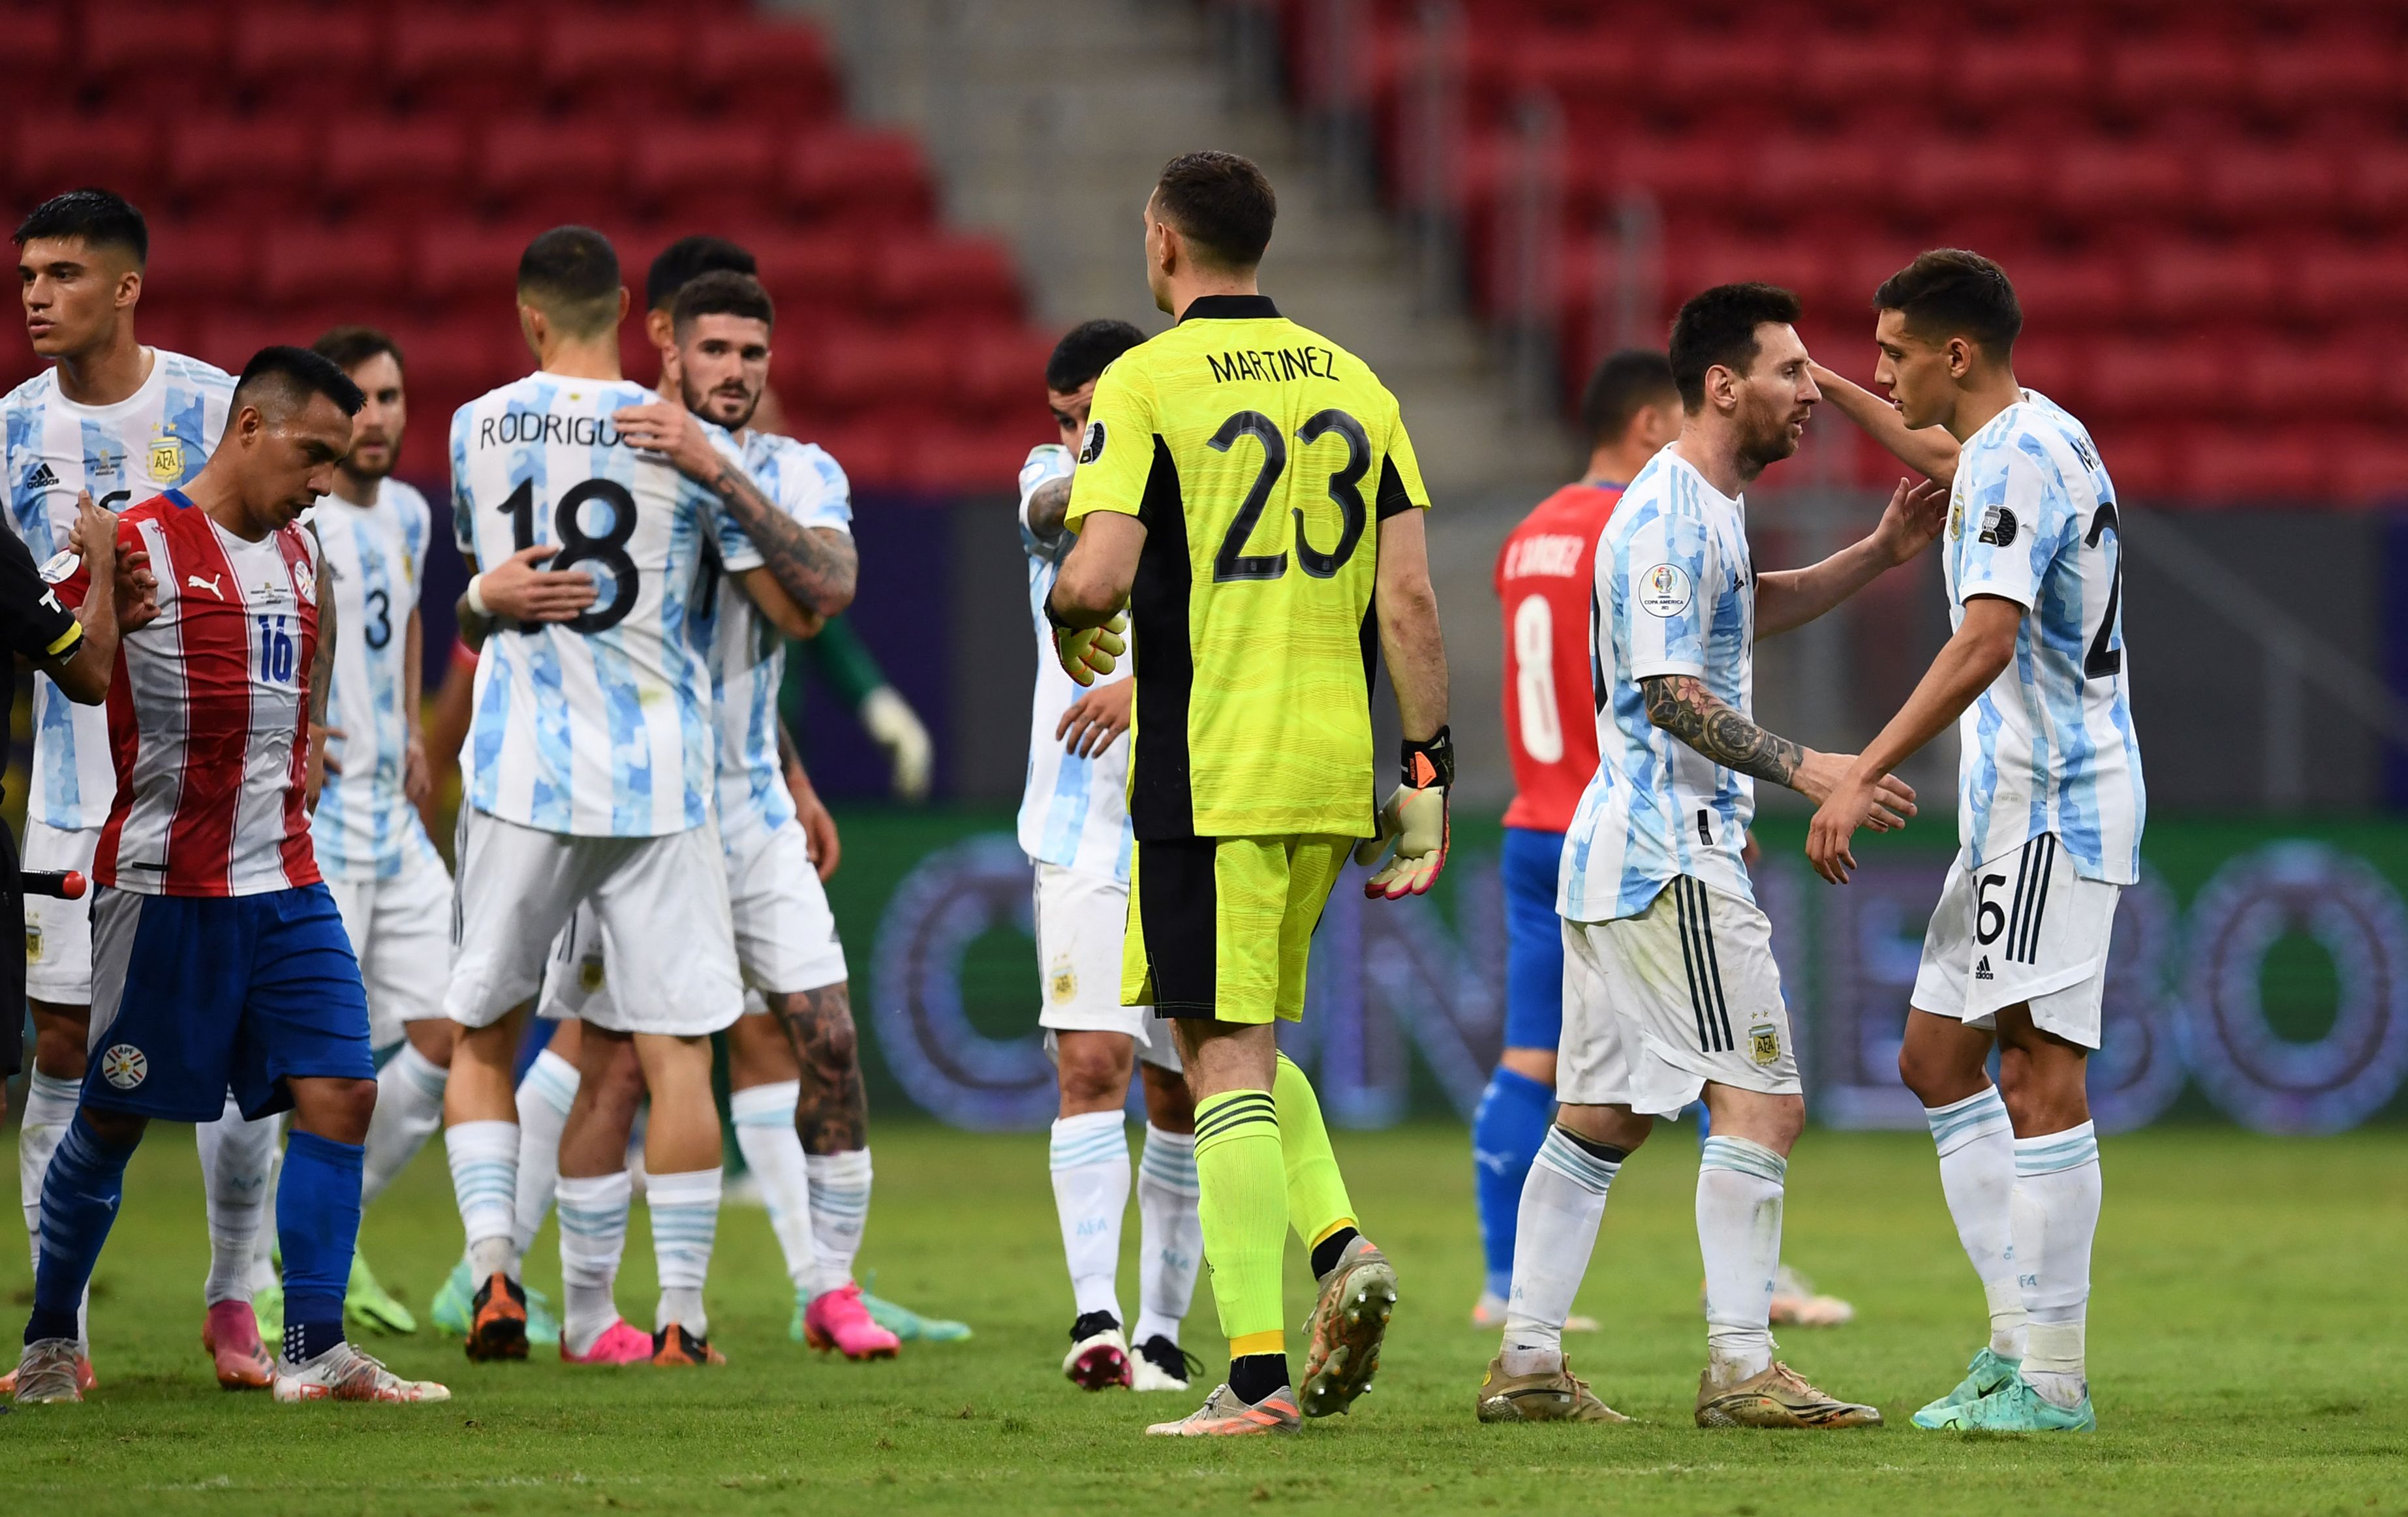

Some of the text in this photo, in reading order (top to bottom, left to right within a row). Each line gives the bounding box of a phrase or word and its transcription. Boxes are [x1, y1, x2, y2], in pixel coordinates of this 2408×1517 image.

[1206, 346, 1340, 383] MARTINEZ
[480, 412, 661, 453] RODRIGU
[155, 450, 175, 470] AFA
[27, 477, 59, 489] adidas
[1205, 409, 1370, 583] 23
[497, 475, 639, 634] 18
[365, 590, 391, 649] 3
[258, 615, 293, 683] 16
[1513, 592, 1564, 765] 8
[118, 1045, 134, 1055] APF
[1757, 1035, 1775, 1054] AFA
[2016, 1274, 2037, 1288] FA
